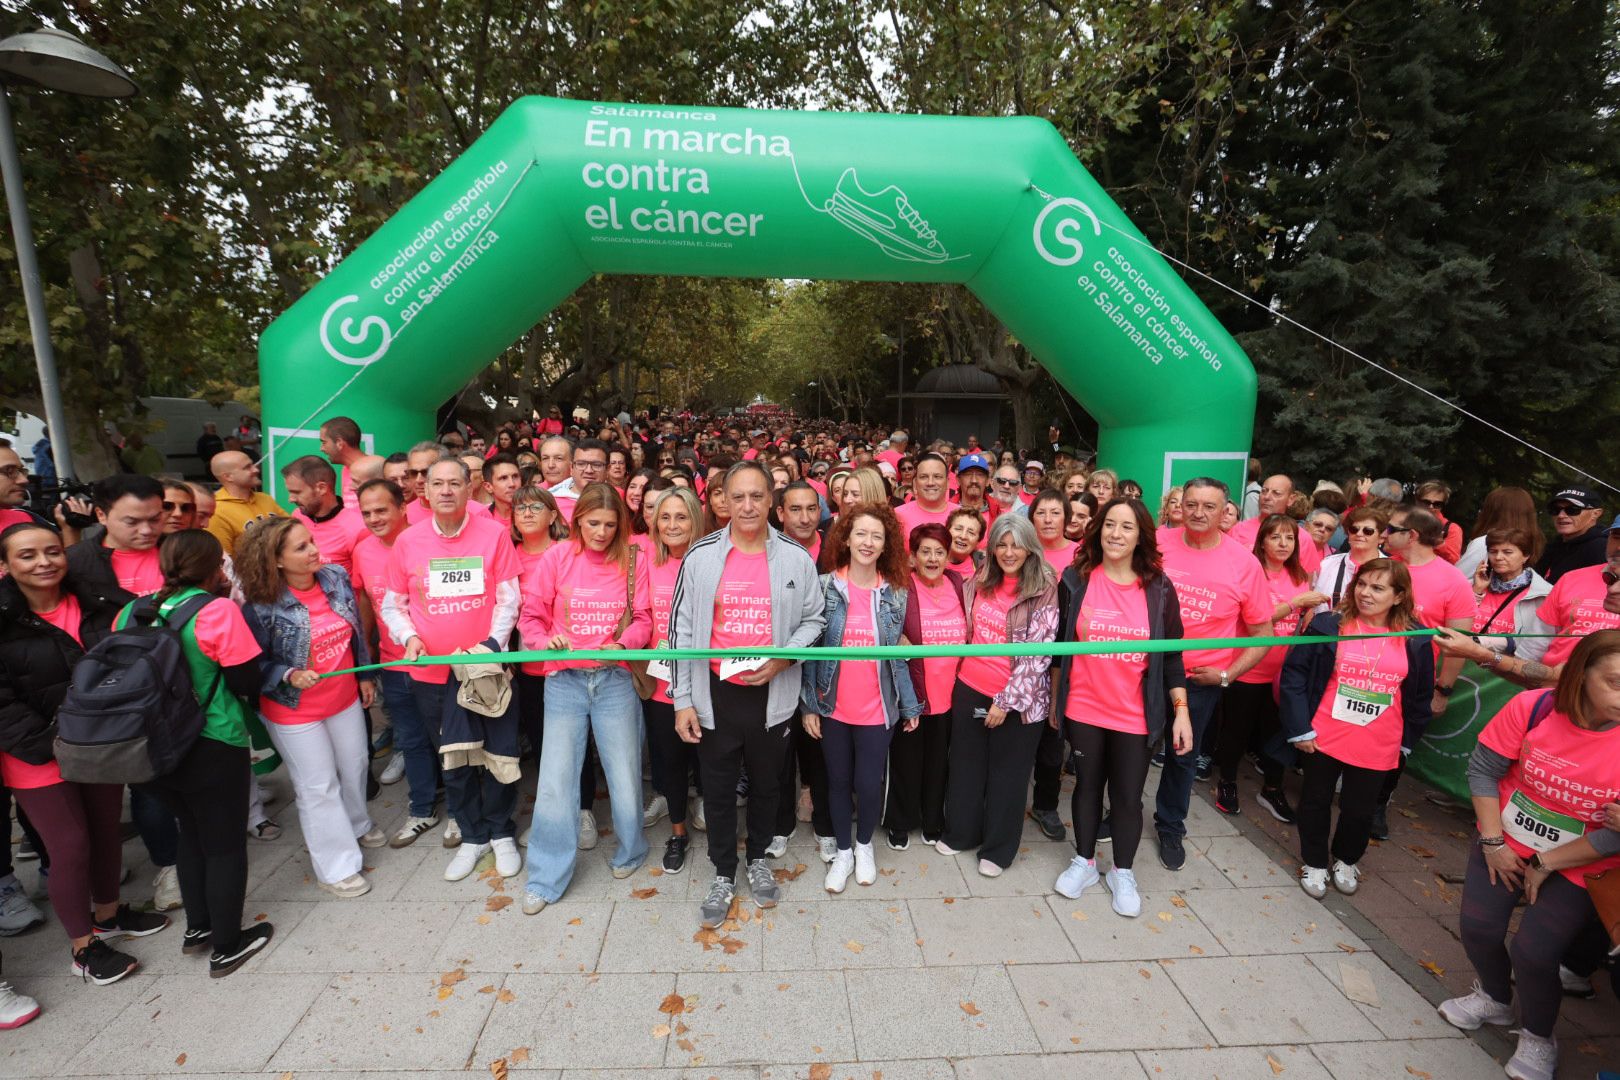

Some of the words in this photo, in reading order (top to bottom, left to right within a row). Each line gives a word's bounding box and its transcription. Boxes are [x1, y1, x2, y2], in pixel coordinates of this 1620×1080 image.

[590, 105, 716, 121] Salamanca
[584, 119, 631, 148] En
[643, 128, 791, 156] marcha
[582, 159, 710, 194] contra
[370, 220, 444, 289] asociación
[444, 160, 508, 222] española
[585, 196, 623, 230] el
[630, 200, 764, 236] cáncer
[384, 260, 431, 305] contra
[430, 244, 446, 264] el
[444, 201, 496, 250] cáncer
[400, 301, 422, 322] en
[418, 229, 500, 304] Salamanca
[1093, 260, 1136, 305] contra
[1134, 302, 1150, 318] el
[1146, 316, 1189, 360] cáncer
[1107, 246, 1172, 316] asociación
[1170, 314, 1222, 372] española
[1078, 275, 1098, 296] en
[1094, 292, 1164, 365] Salamanca
[441, 570, 471, 584] 2629
[427, 596, 488, 615] cáncer
[570, 598, 585, 608] En
[588, 600, 628, 609] march
[722, 594, 738, 605] En
[980, 602, 992, 613] En
[1198, 600, 1213, 611] el
[570, 611, 614, 622] contra
[723, 607, 768, 619] contra
[1577, 608, 1592, 617] En
[1090, 620, 1105, 631] En
[1108, 624, 1150, 638] march
[1340, 663, 1356, 674] En
[1346, 699, 1380, 716] 11561
[1524, 759, 1546, 778] En
[1524, 774, 1597, 809] contra
[1514, 811, 1561, 842] 5905
